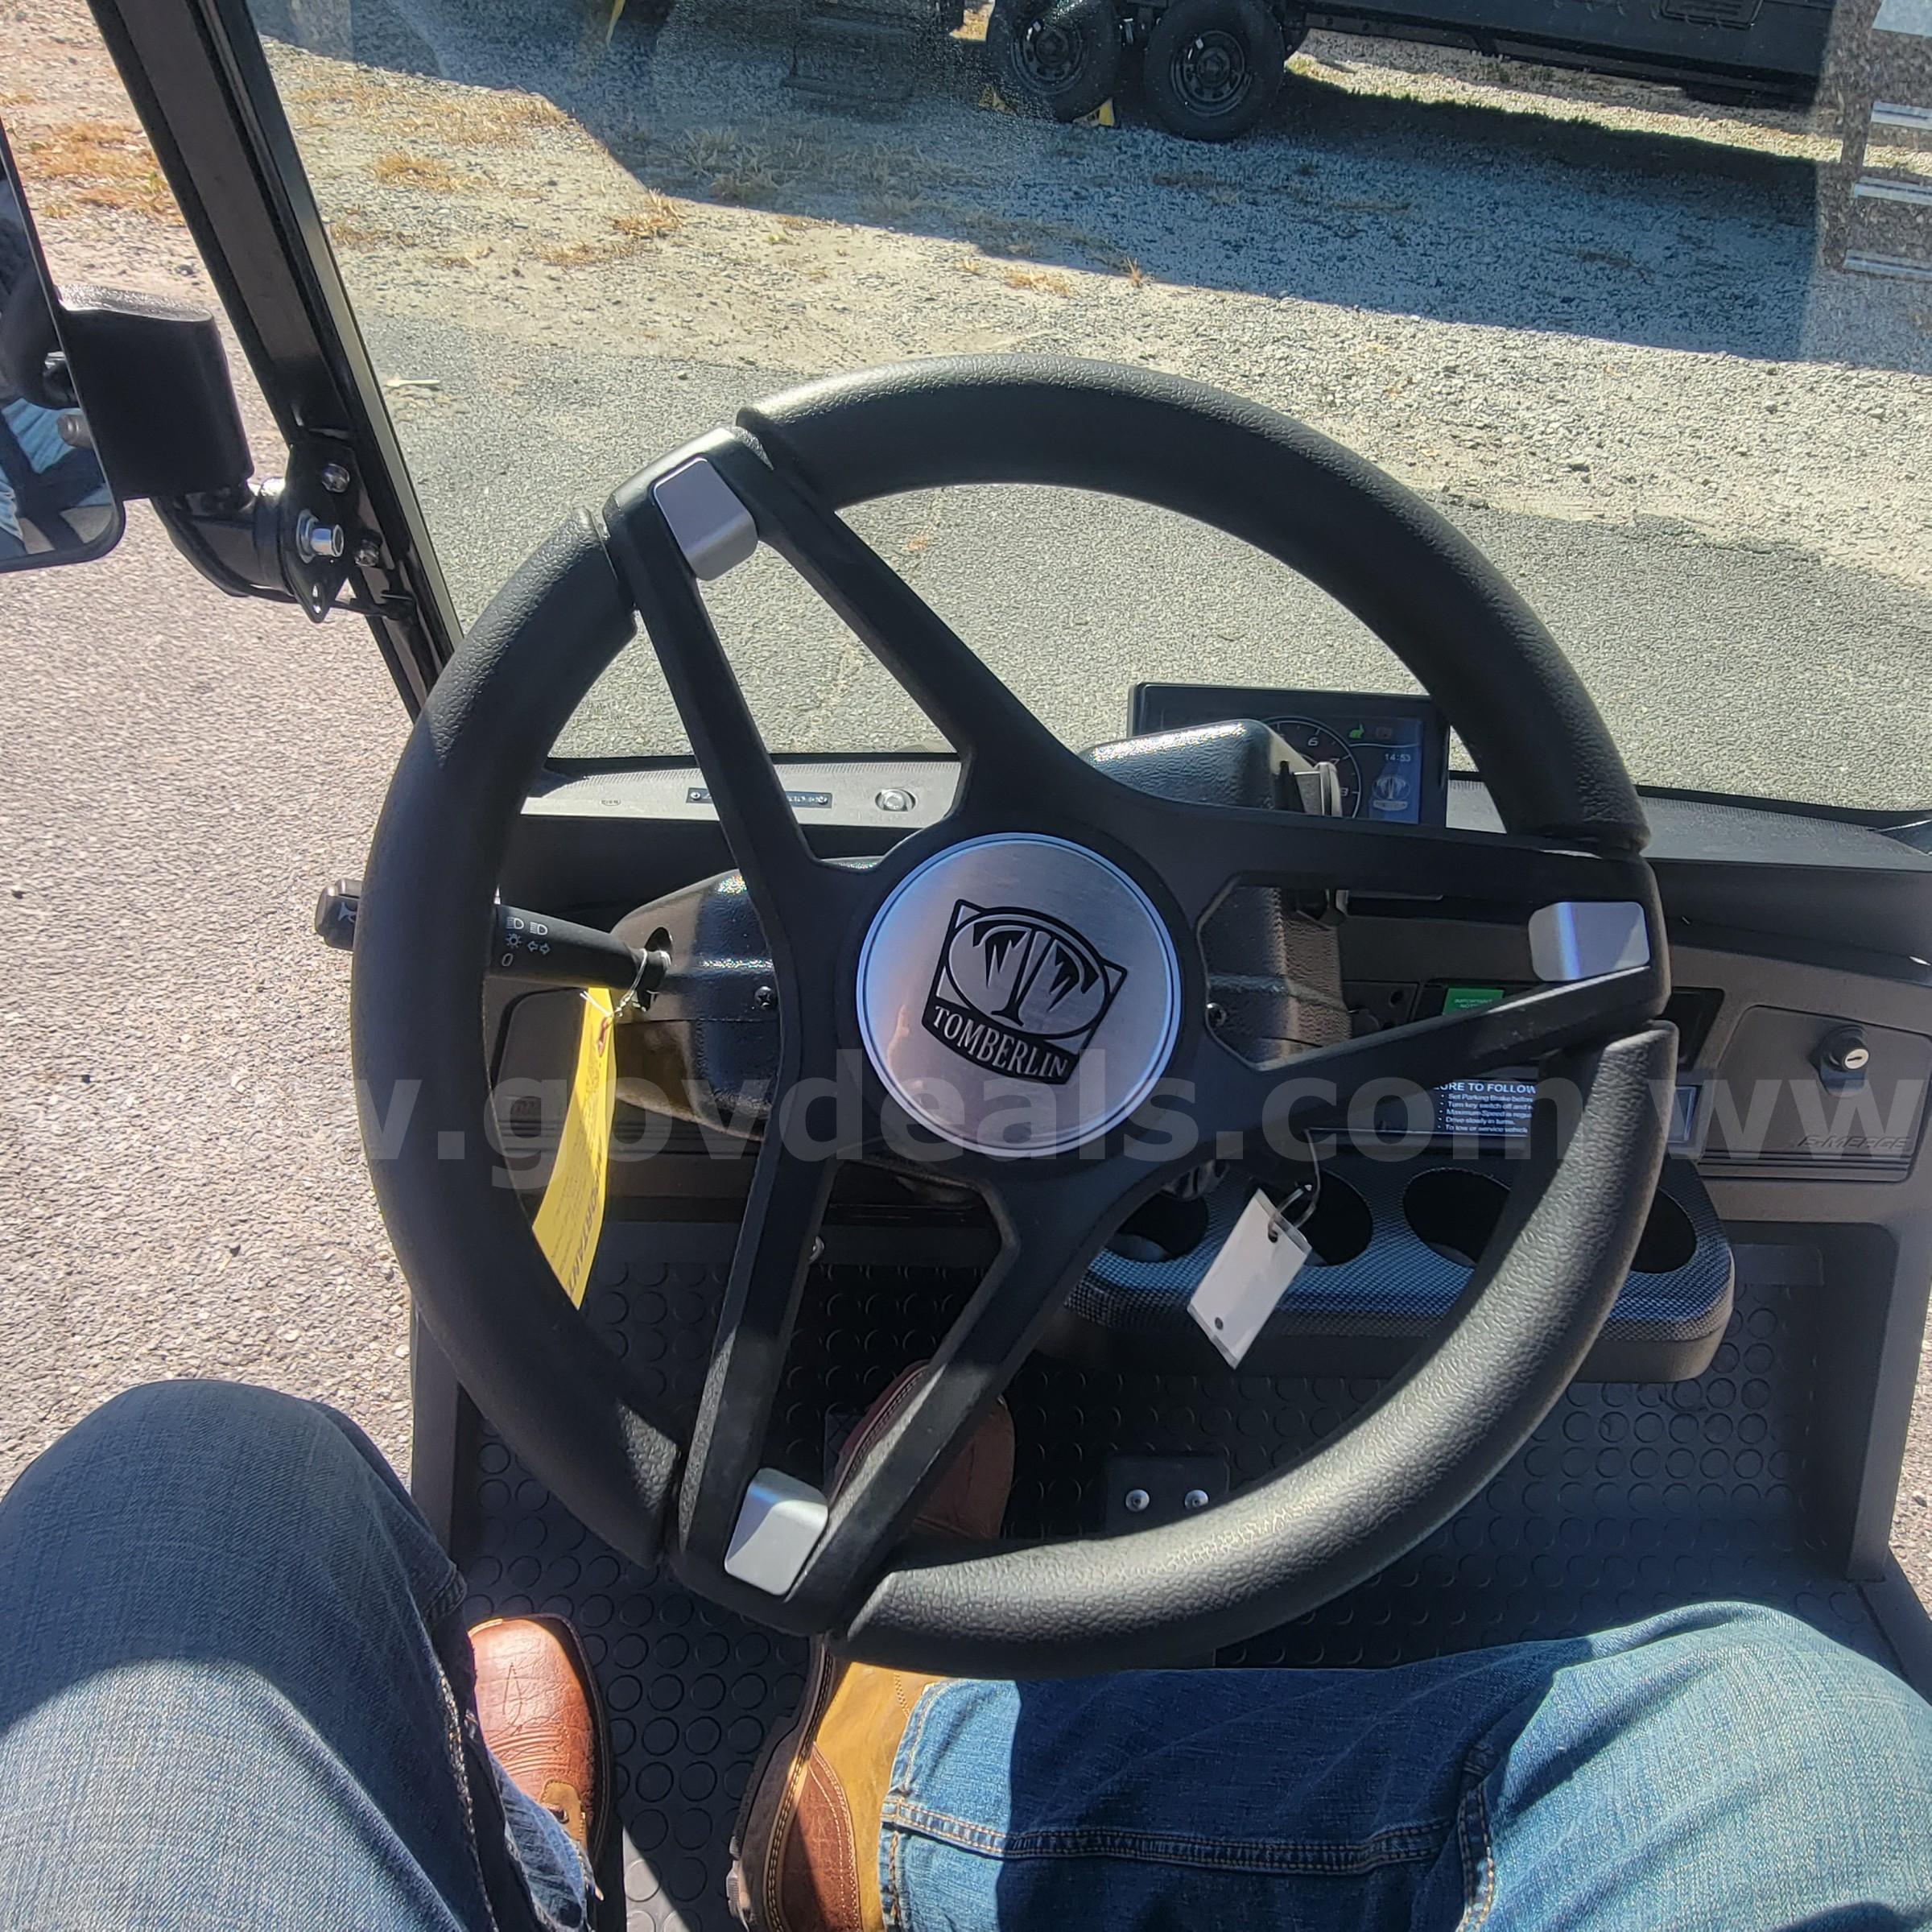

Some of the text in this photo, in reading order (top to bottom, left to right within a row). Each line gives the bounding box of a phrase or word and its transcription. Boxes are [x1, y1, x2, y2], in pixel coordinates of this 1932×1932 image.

[1308, 737, 1319, 746] 6
[934, 1005, 1069, 1078] TOMBERLIN
[1434, 1083, 1537, 1094] URE TO FOLLOW
[1462, 1094, 1489, 1102] Parking
[1465, 1101, 1479, 1109] key
[1445, 1116, 1465, 1124] Drive
